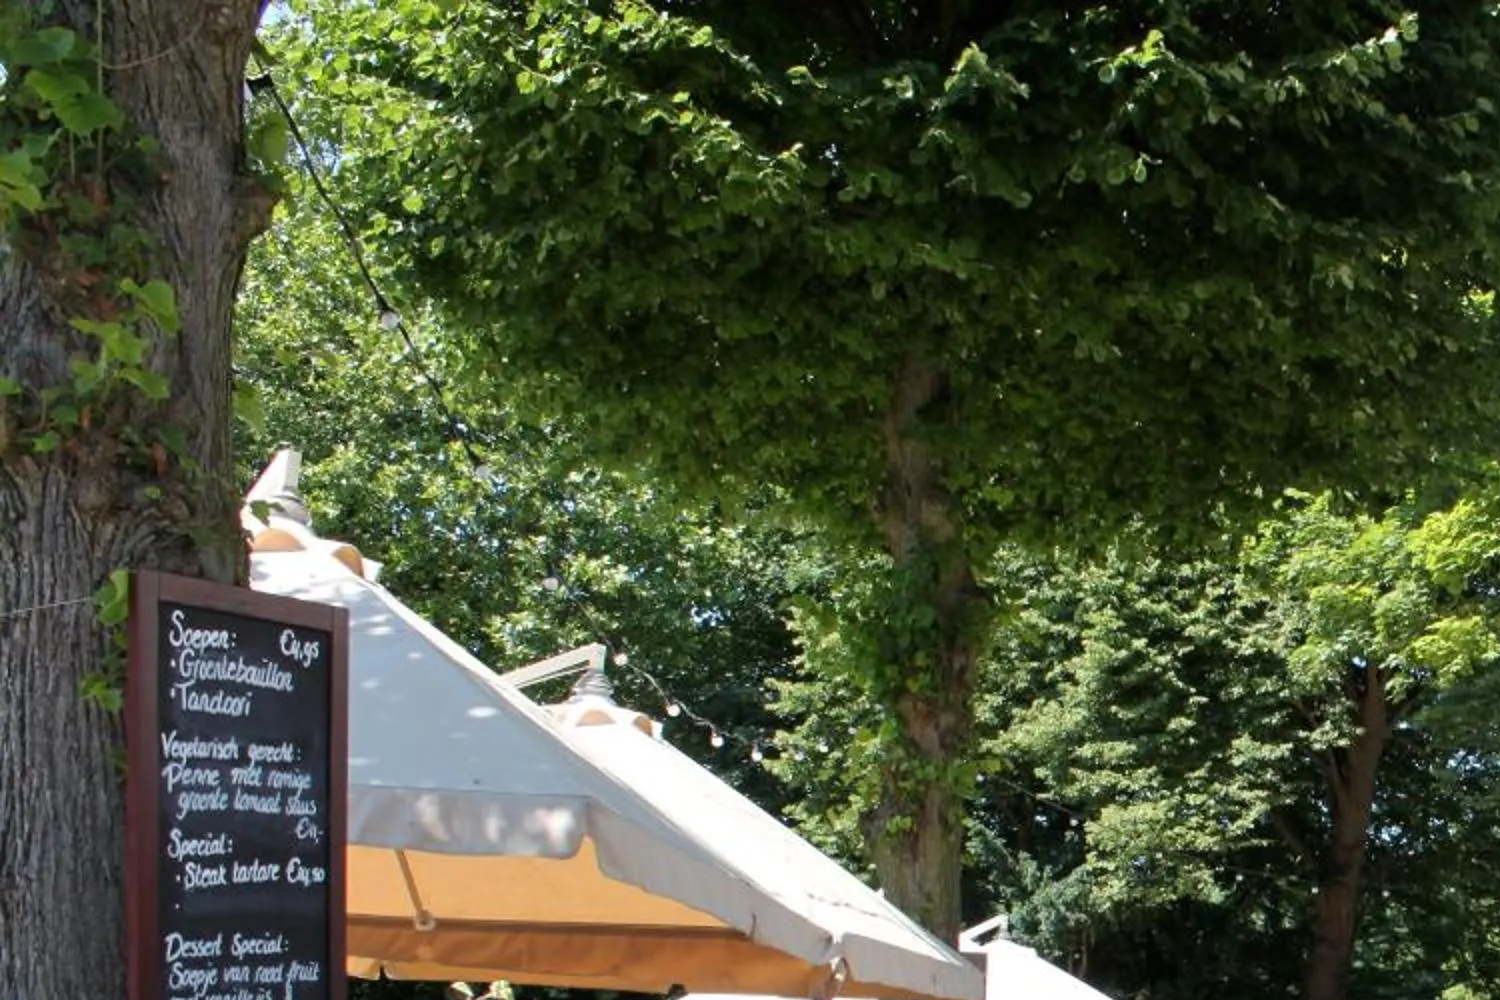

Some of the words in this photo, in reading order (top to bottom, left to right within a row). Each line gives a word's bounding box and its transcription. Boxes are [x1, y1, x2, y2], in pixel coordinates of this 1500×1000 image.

[169, 609, 237, 655] Soepen:
[179, 647, 294, 692] Groentebouillon
[174, 678, 253, 717] Tandoori
[161, 730, 239, 765] Vegetarisch
[248, 741, 302, 772] gerecht:
[161, 761, 221, 794] Penne
[230, 766, 262, 787] met
[267, 768, 312, 800] romige
[176, 786, 229, 820] groente
[233, 787, 281, 814] tomaat
[285, 793, 317, 816] saus
[167, 827, 233, 862] Special:
[184, 861, 227, 891] Steak
[232, 858, 280, 884] tartare
[164, 932, 223, 963] Dessert
[231, 931, 289, 960] Special:
[169, 961, 218, 998] Soepje
[223, 965, 250, 983] van
[285, 960, 320, 984] fruit
